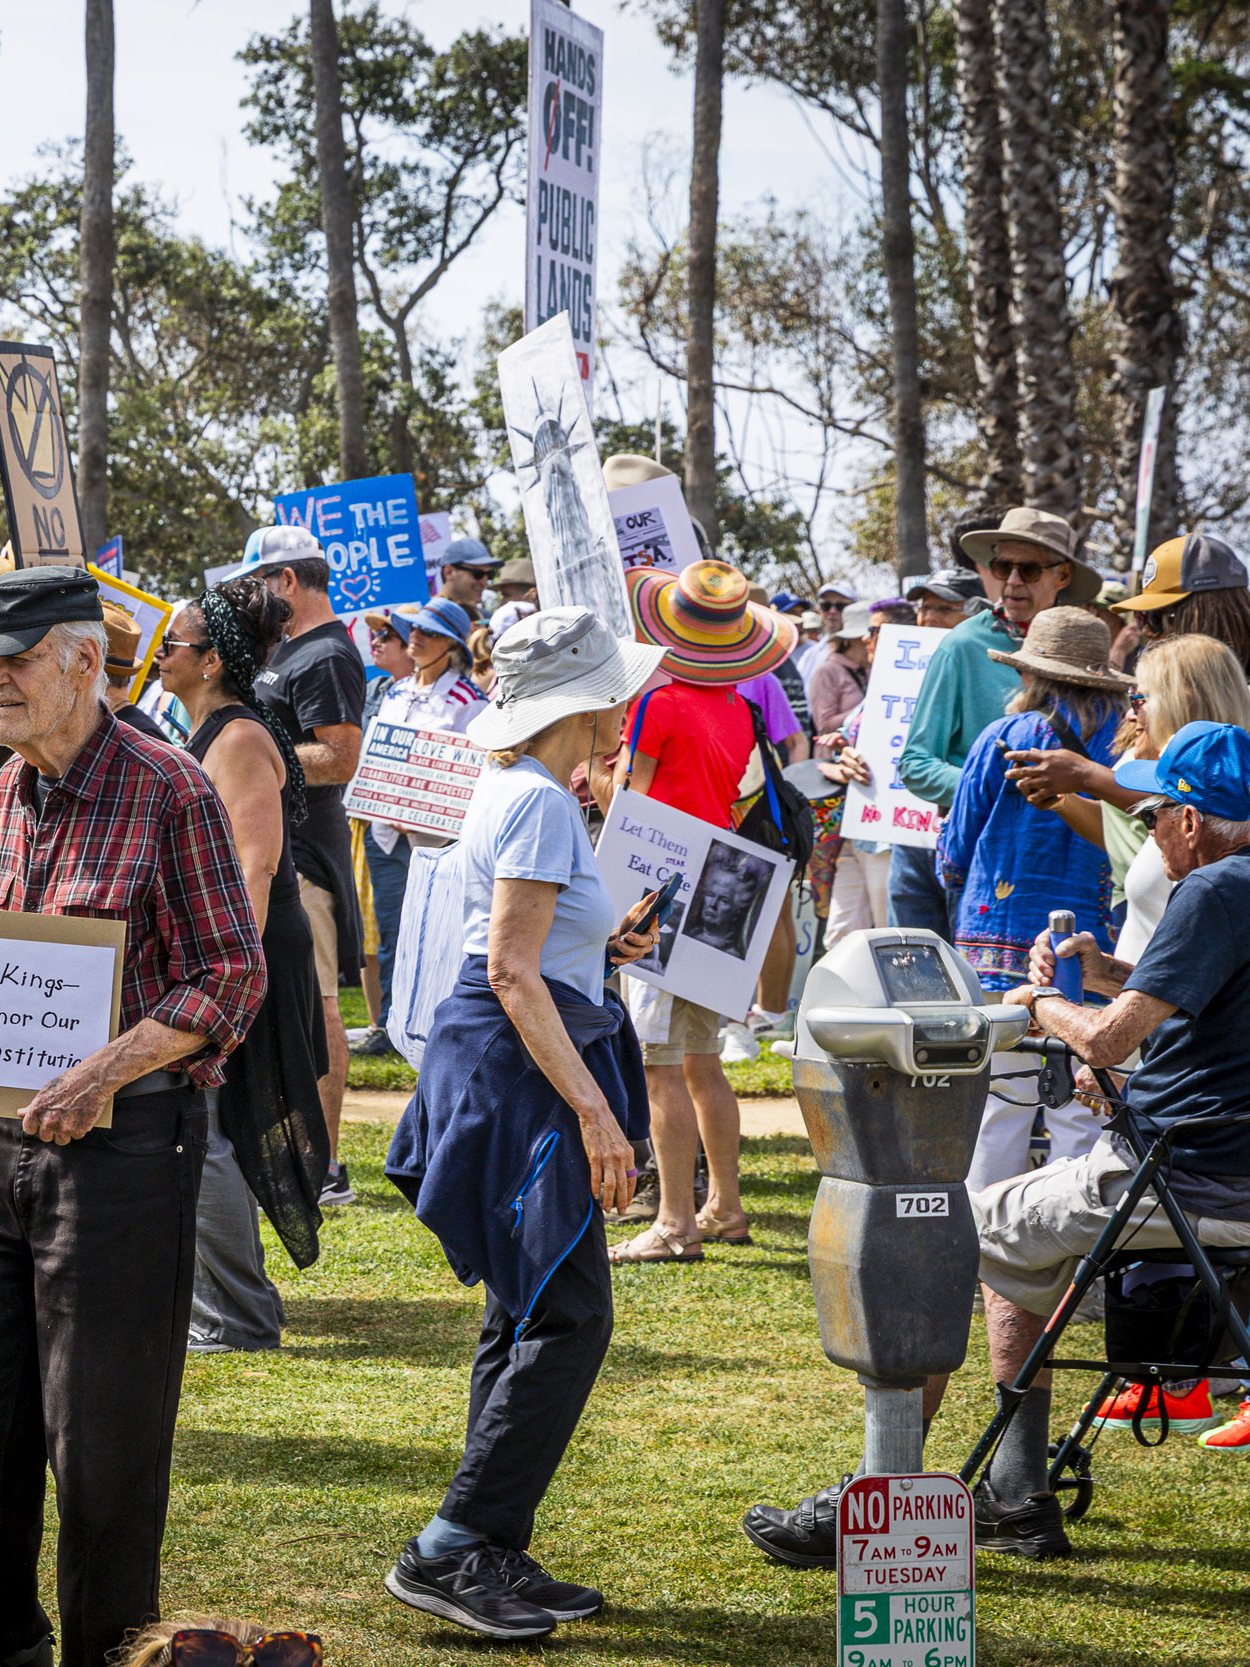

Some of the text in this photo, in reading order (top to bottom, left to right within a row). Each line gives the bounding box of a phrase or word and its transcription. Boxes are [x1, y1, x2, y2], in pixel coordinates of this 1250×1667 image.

[543, 28, 596, 98] HANDS
[542, 80, 595, 174] OFF!
[537, 178, 595, 265] PUBLIC
[536, 264, 592, 344] LANDS
[32, 503, 66, 548] NO
[277, 495, 409, 537] WE THE
[625, 511, 657, 530] OUR
[325, 533, 415, 572] OPLE
[368, 742, 409, 760] AMERICA
[373, 725, 416, 747] IN OUR
[413, 740, 447, 759] LOVE
[453, 750, 486, 767] WINS
[360, 767, 409, 785] DISABILITIES
[410, 778, 426, 790] ARE
[347, 797, 463, 830] DIVERSITY IS CELEBRATED
[618, 815, 688, 857] Let Them
[627, 854, 652, 877] Eat
[41, 1011, 80, 1032] Our
[899, 1195, 947, 1216] 702
[847, 1491, 966, 1530] NO PARKING
[852, 1535, 958, 1562] 7AM TO 9AM
[863, 1565, 947, 1586] TUESDAY
[853, 1596, 955, 1639] 5 HOUR
[894, 1617, 967, 1644] PARKING
